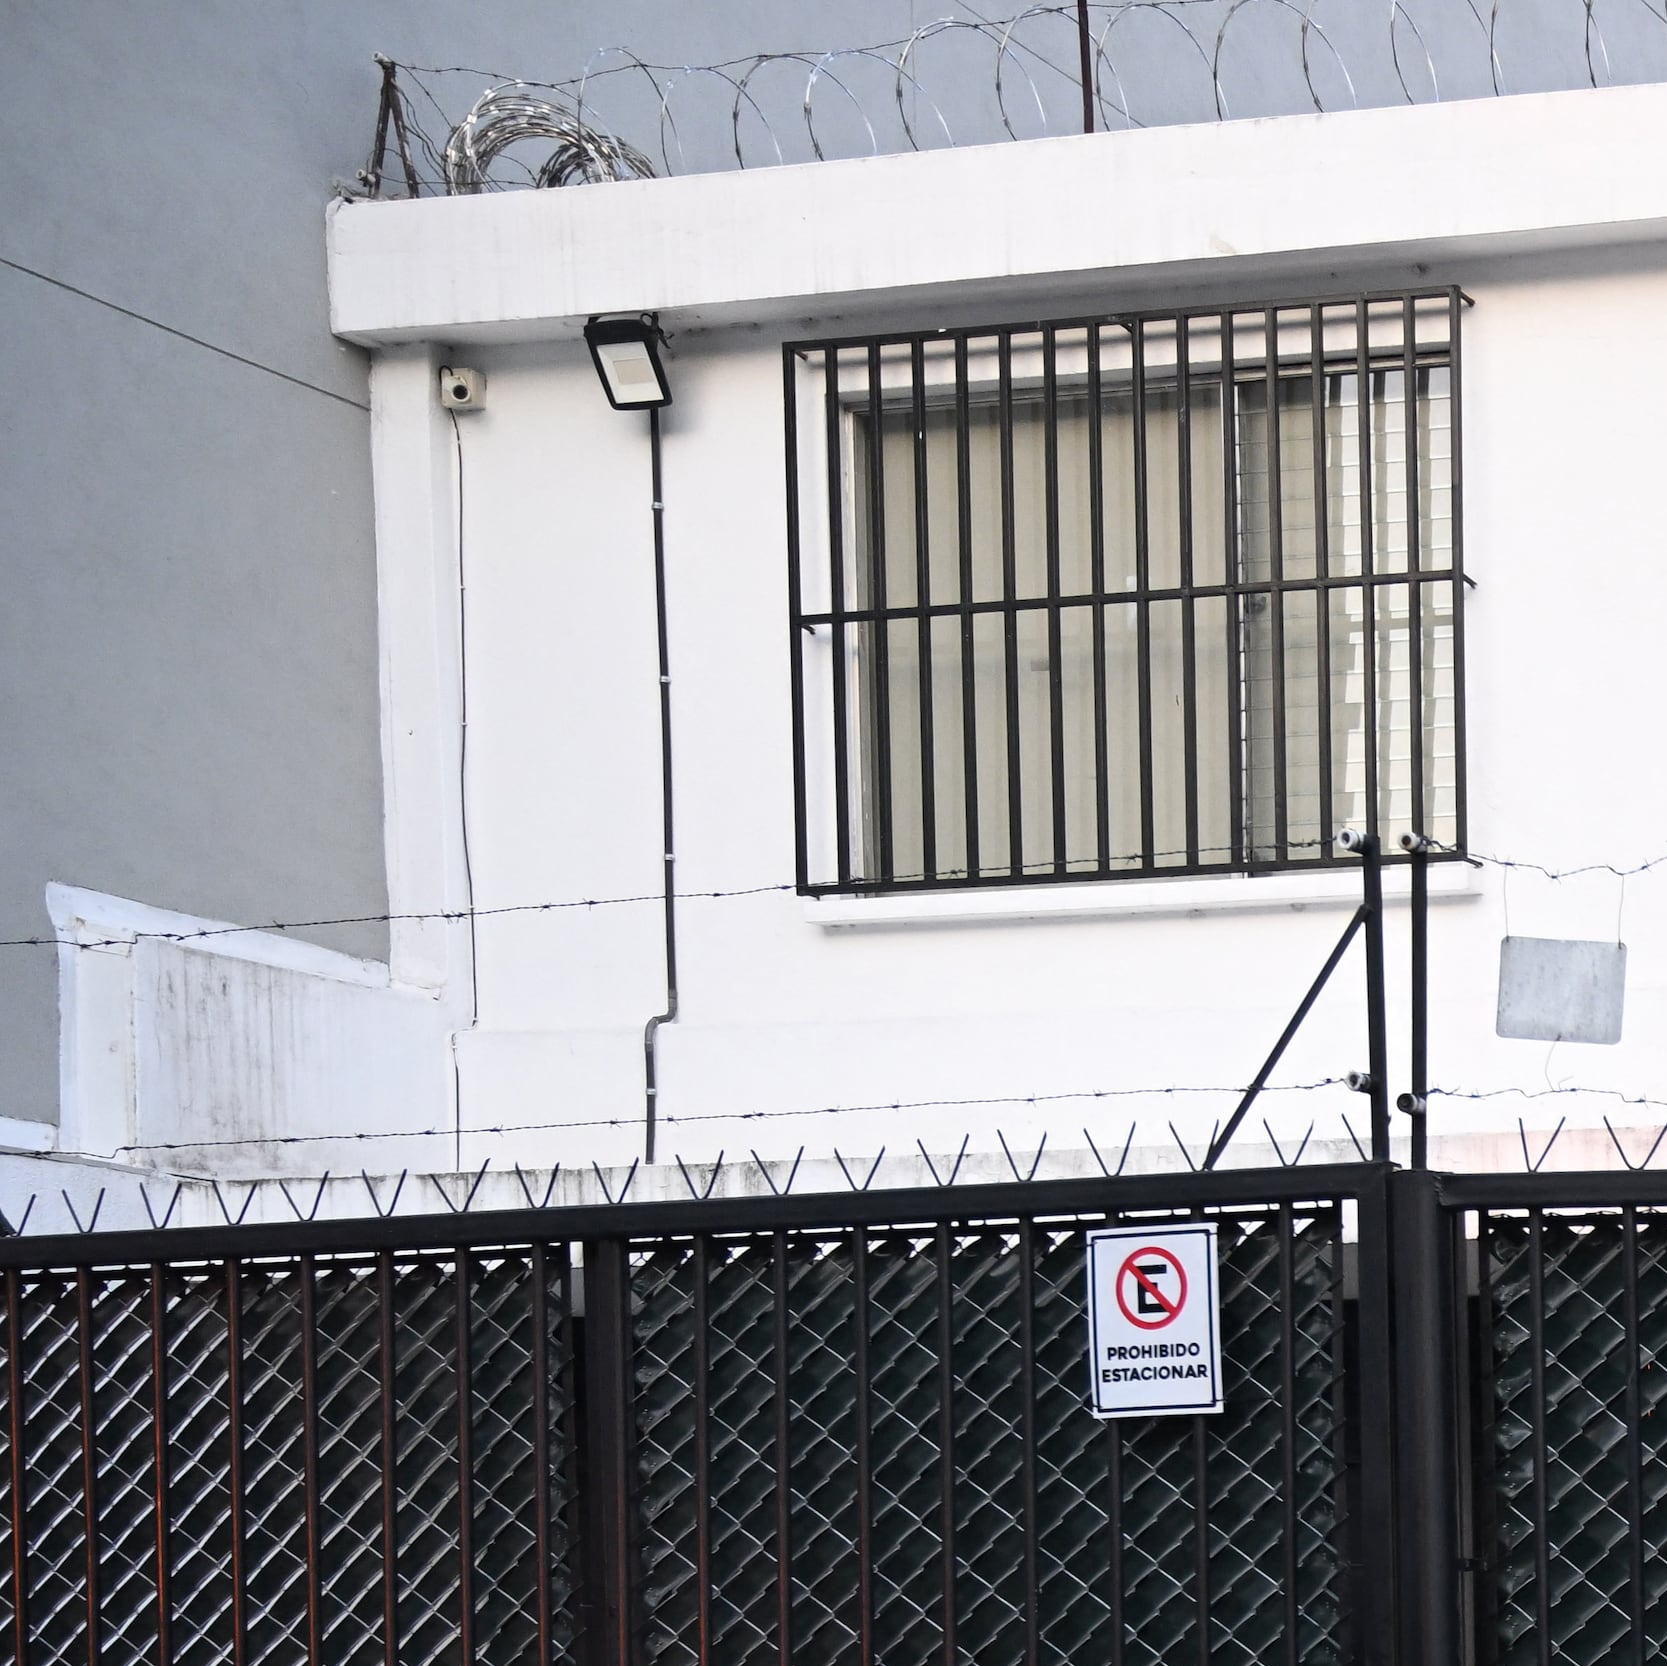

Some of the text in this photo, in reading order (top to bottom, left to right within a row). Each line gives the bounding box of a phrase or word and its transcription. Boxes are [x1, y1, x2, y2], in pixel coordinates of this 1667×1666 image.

[1137, 1264, 1167, 1314] E
[1107, 1342, 1200, 1360] PROHIBIDO
[1102, 1364, 1208, 1383] ESTACIONAR
